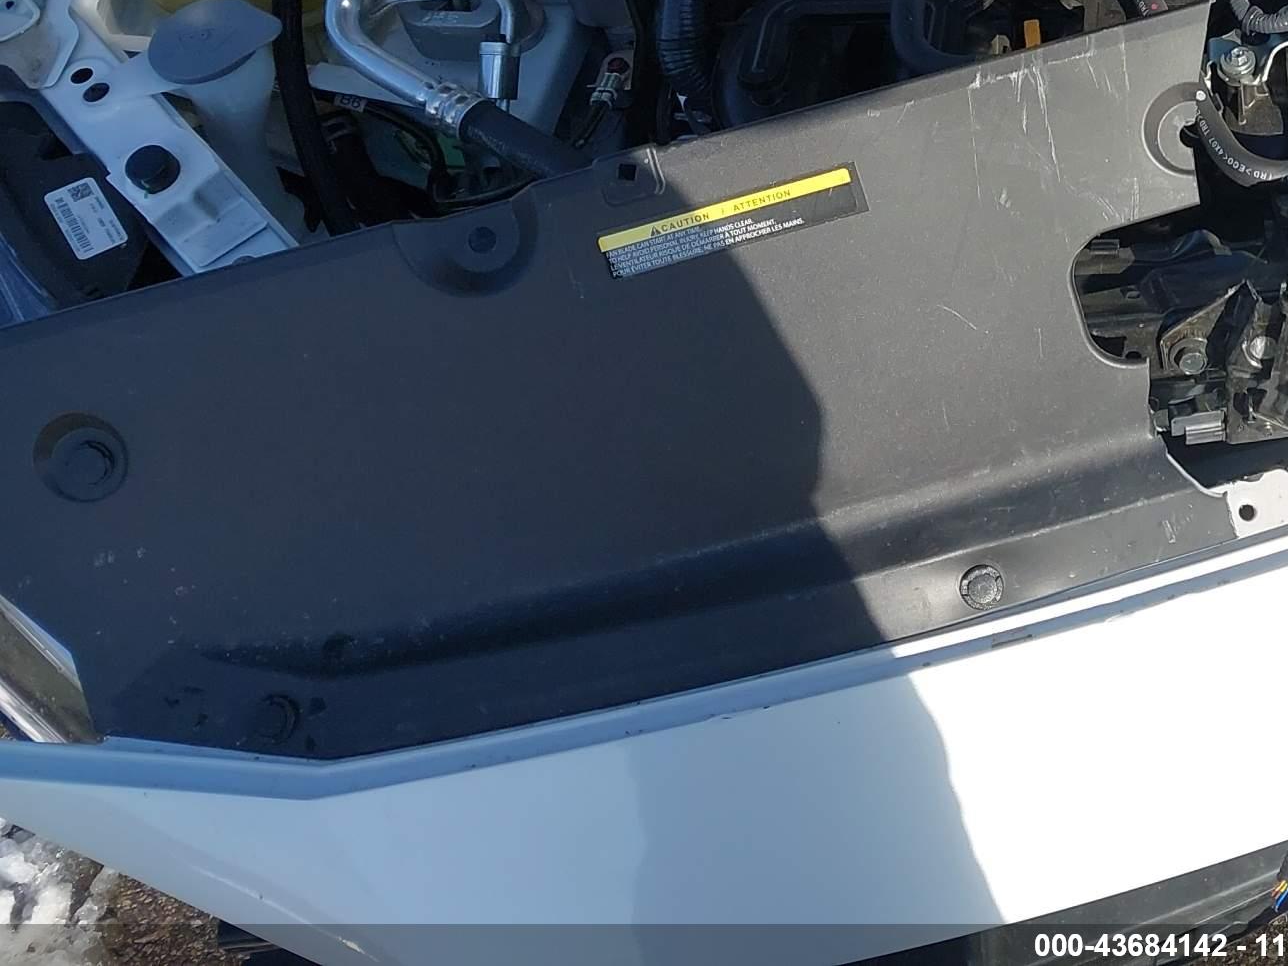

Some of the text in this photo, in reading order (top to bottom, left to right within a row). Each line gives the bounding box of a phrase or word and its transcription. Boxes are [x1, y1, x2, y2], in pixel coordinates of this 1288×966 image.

[661, 212, 709, 232] CAUTION
[732, 189, 791, 212] ATTENTION
[611, 267, 631, 277] POUR
[651, 255, 672, 266] TOUTE
[702, 243, 713, 251] NE
[713, 239, 725, 248] PAS
[724, 237, 734, 245] EN
[734, 226, 771, 242] APPROCHER
[770, 223, 782, 231] LES
[617, 253, 631, 262] HELP
[632, 248, 649, 257] AVOID
[649, 239, 679, 253] PERSONAL
[713, 223, 734, 234] HANDS
[617, 252, 657, 269] VENTILATEUR
[658, 245, 680, 257] RISQUE
[681, 242, 690, 250] DE
[729, 226, 746, 236] TOUT
[649, 236, 666, 246] START
[666, 233, 674, 241] AT
[674, 230, 686, 238] ANY
